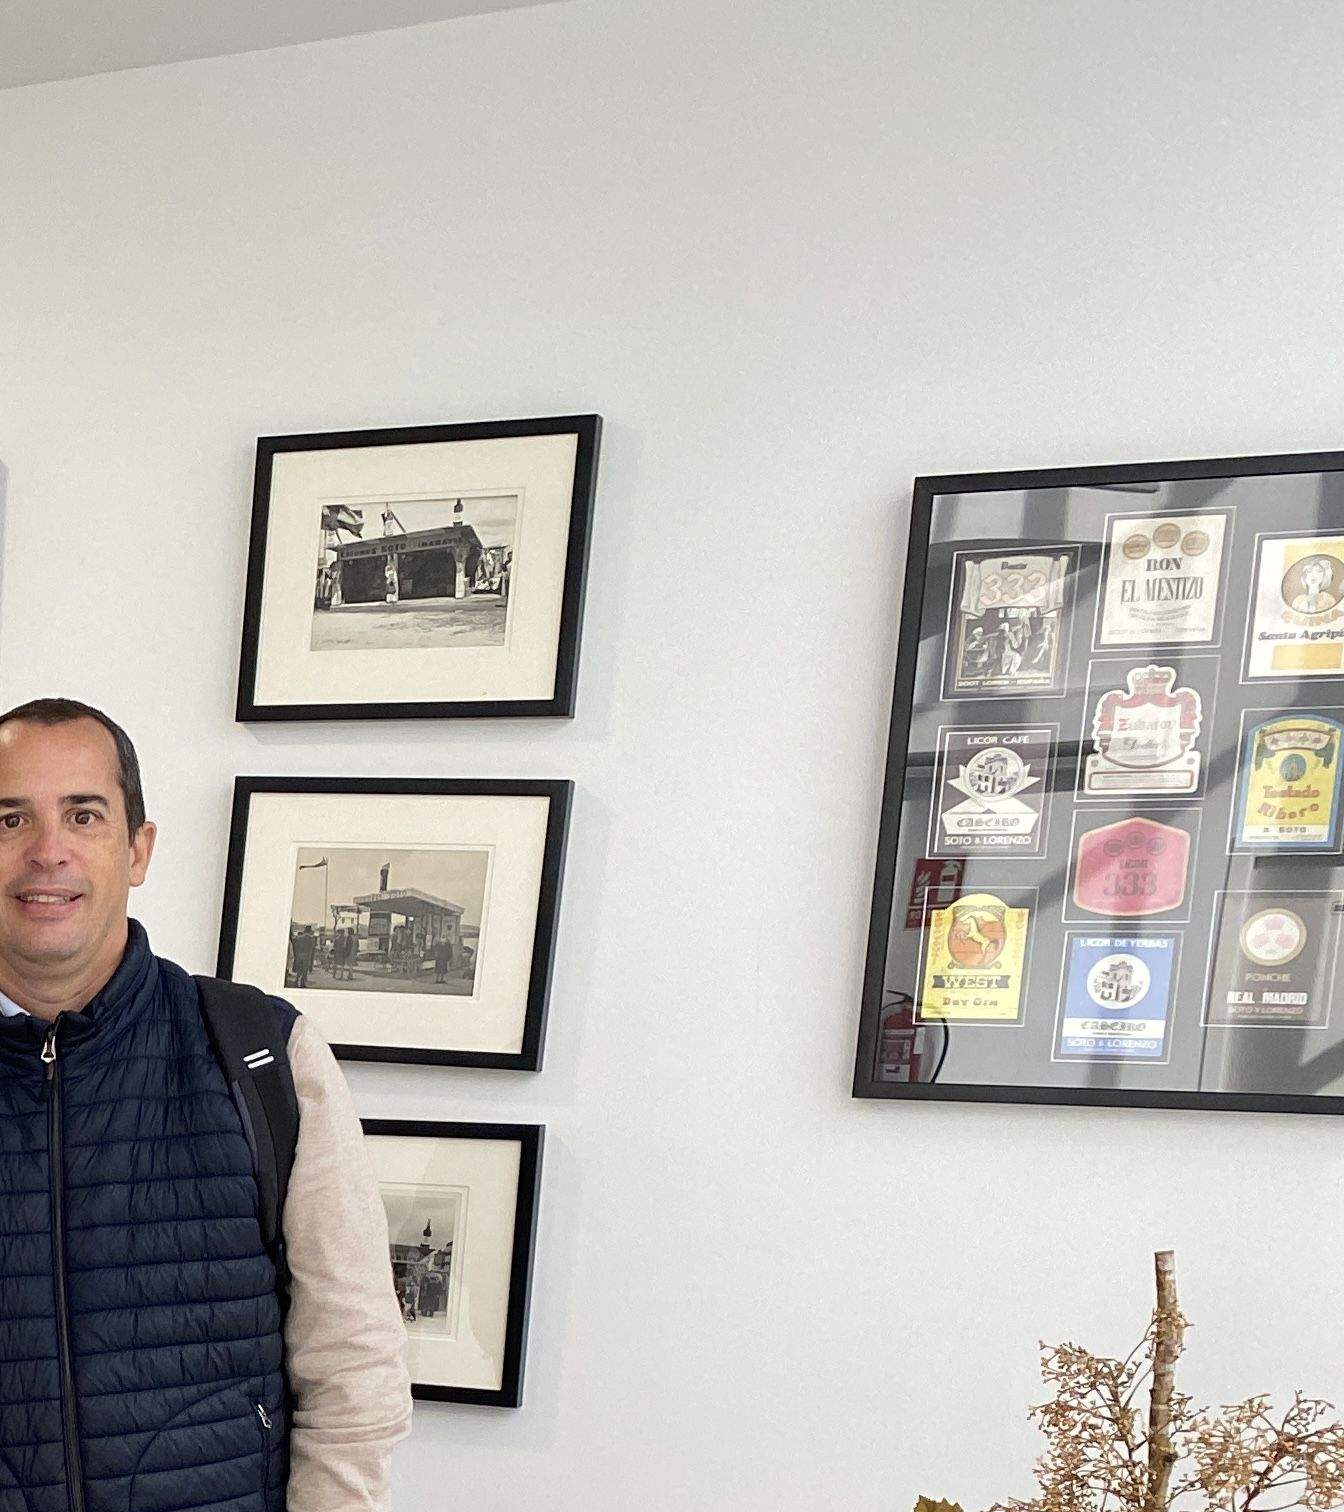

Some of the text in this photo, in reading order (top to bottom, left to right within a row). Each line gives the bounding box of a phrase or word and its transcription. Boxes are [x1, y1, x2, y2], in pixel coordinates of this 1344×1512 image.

[1145, 557, 1183, 572] RON
[1120, 576, 1204, 604] EL MESTIZO
[1257, 632, 1297, 641] Santa
[967, 735, 998, 746] LICOR
[944, 835, 972, 846] SOTO
[983, 835, 1032, 846] LORENZO
[942, 975, 1002, 989] WEST
[1227, 991, 1308, 1005] REAL MADRID
[1067, 1038, 1096, 1048] SOTO
[1107, 1038, 1158, 1049] LORENZO
